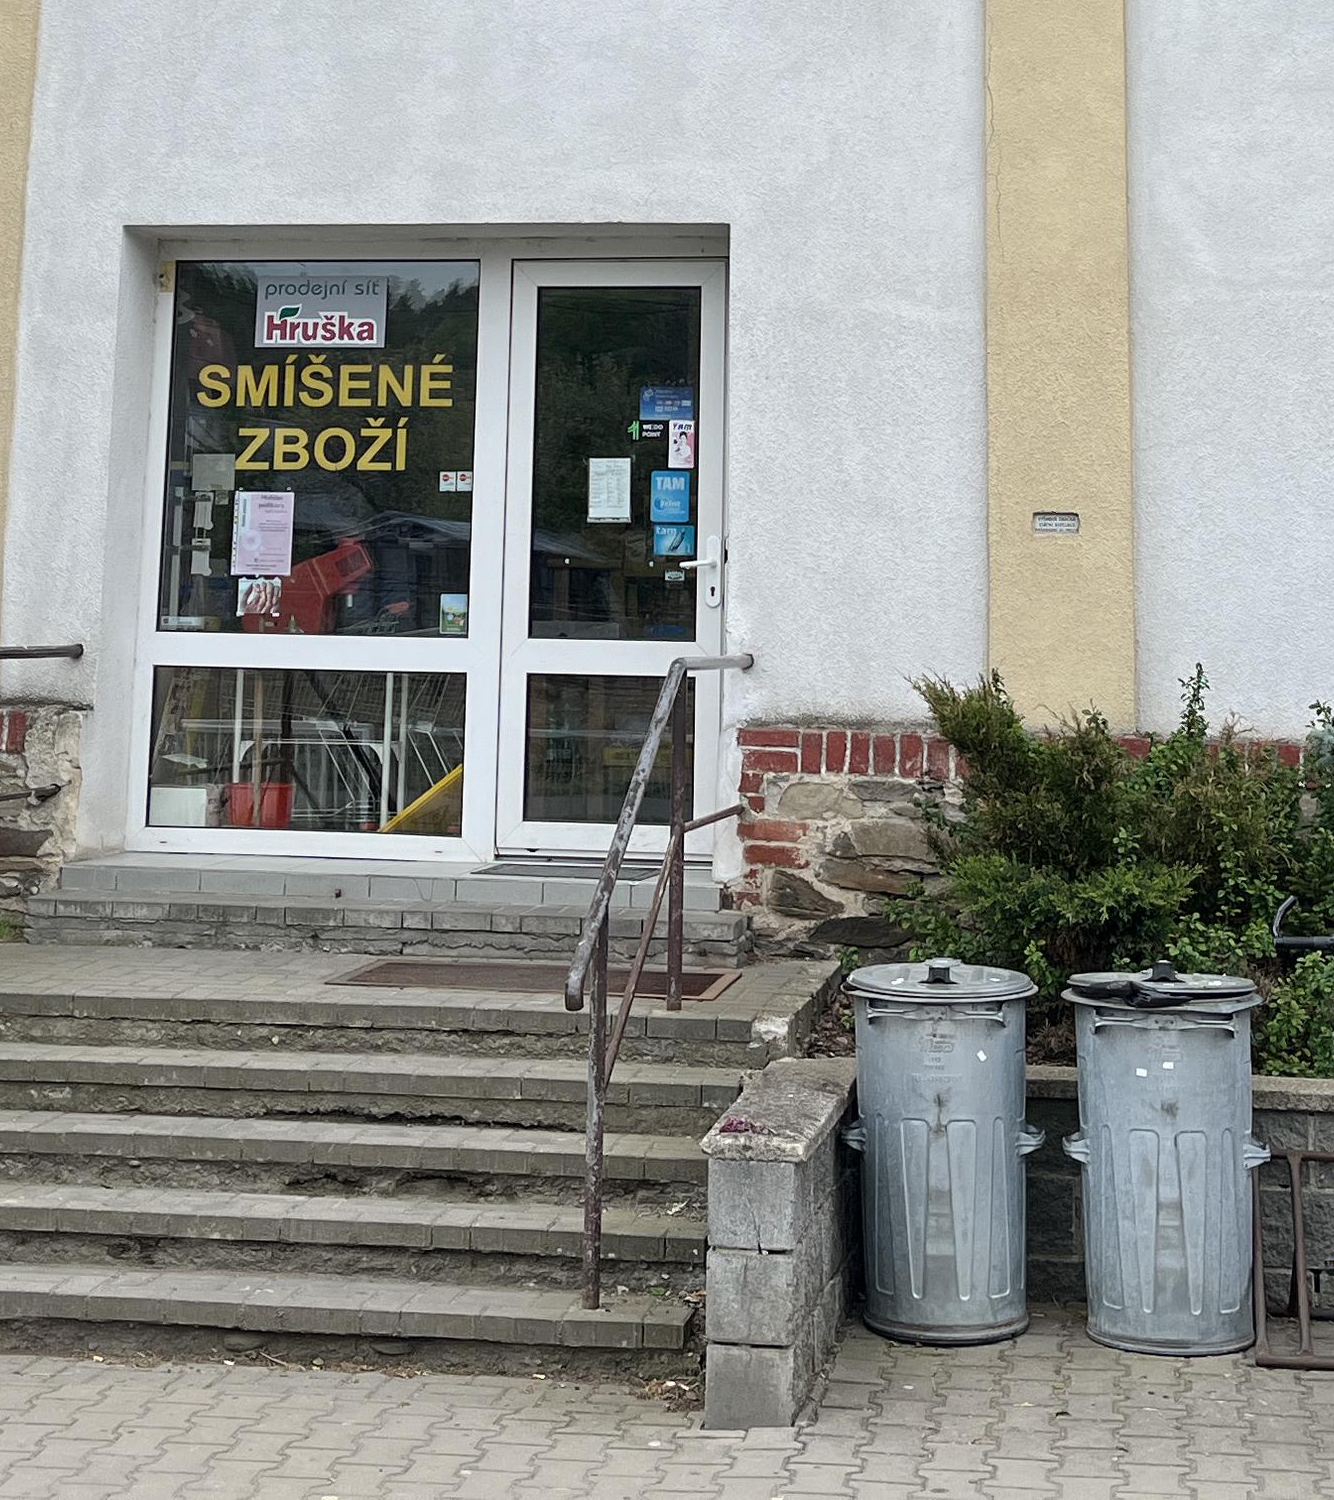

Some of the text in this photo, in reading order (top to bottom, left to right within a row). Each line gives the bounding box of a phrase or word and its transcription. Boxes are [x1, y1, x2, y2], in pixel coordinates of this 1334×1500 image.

[265, 280, 346, 300] prodejní
[266, 314, 375, 341] Hruška
[196, 353, 453, 408] SMÍŠENÉ
[235, 416, 409, 471] ZBOŽÍ
